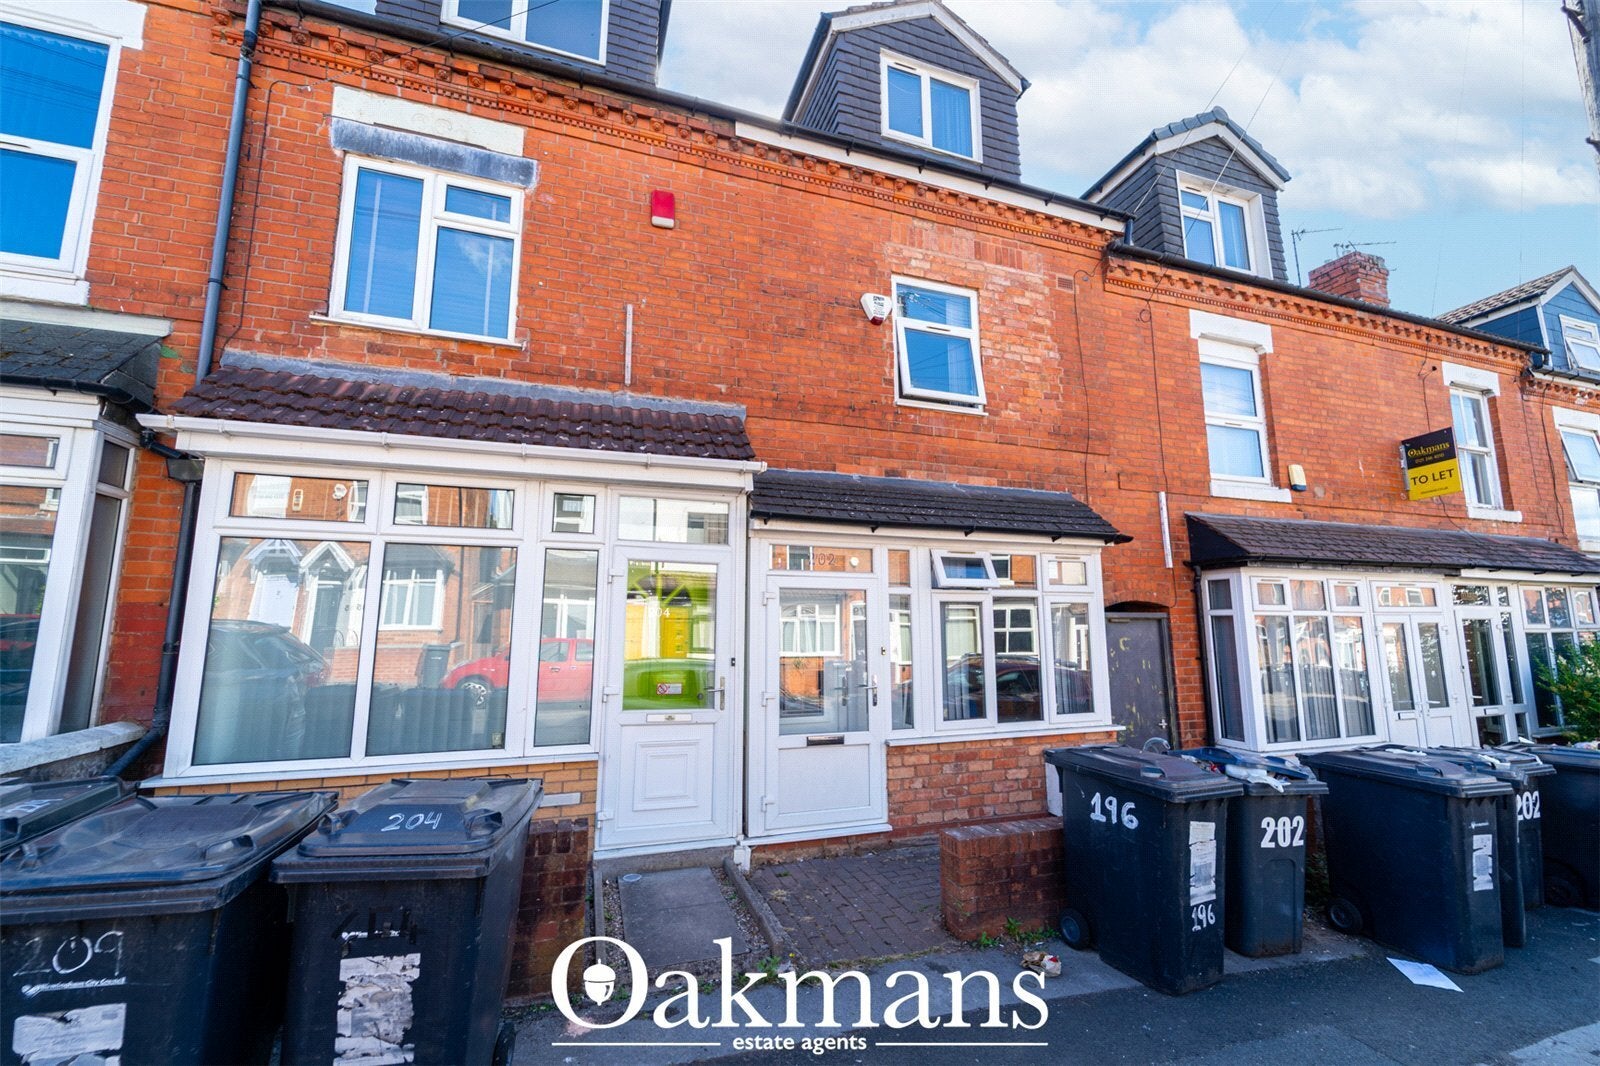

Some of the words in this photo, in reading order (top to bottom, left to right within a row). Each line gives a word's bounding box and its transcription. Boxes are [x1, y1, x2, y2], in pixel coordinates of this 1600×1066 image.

[1407, 442, 1450, 457] Oakmans
[1411, 475, 1429, 486] TO
[1432, 468, 1455, 482] LET
[381, 811, 442, 832] 204
[1090, 791, 1139, 830] 196
[1260, 815, 1305, 848] 202
[1191, 903, 1216, 932] 196
